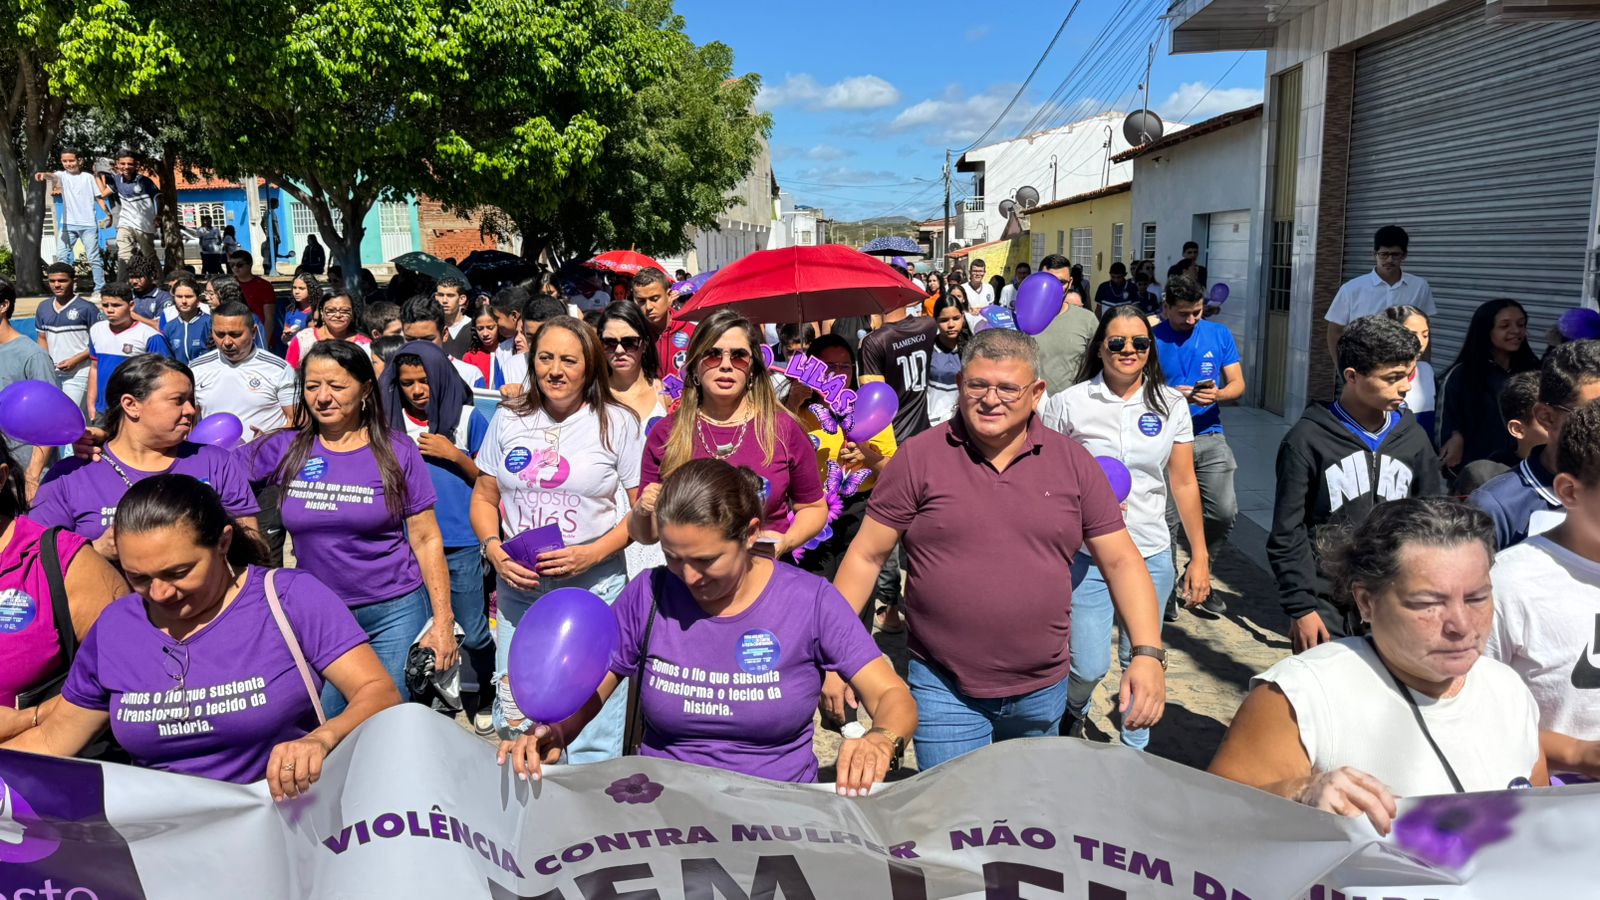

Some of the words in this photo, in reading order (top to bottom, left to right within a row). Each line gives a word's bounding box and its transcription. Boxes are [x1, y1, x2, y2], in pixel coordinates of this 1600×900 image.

[892, 333, 926, 350] FLAMENGO
[896, 350, 927, 391] 10
[308, 481, 314, 489] o
[315, 481, 325, 490] fio
[326, 483, 341, 493] que
[341, 484, 375, 495] sustenta
[329, 493, 336, 501] o
[337, 493, 361, 503] tecido
[363, 495, 373, 504] da
[512, 486, 581, 508] Agosto
[304, 500, 338, 511] história.
[652, 658, 679, 677] Somos
[682, 668, 689, 679] o
[691, 668, 706, 682] fio
[709, 672, 730, 685] que
[732, 670, 780, 684] sustenta
[153, 691, 162, 704] o
[209, 676, 265, 698] sustenta
[649, 675, 656, 687] e
[655, 676, 714, 699] transforma
[717, 689, 725, 700] o
[728, 687, 764, 701] tecido
[767, 686, 782, 700] da
[194, 705, 202, 717] o
[206, 698, 247, 716] tecido
[250, 692, 267, 708] da
[683, 699, 734, 716] história.
[158, 719, 214, 736] história.
[322, 804, 525, 879] VIOLÊNCIA
[534, 826, 719, 875] CONTRA
[949, 819, 1056, 850] NÃO
[1073, 835, 1174, 886] TEM
